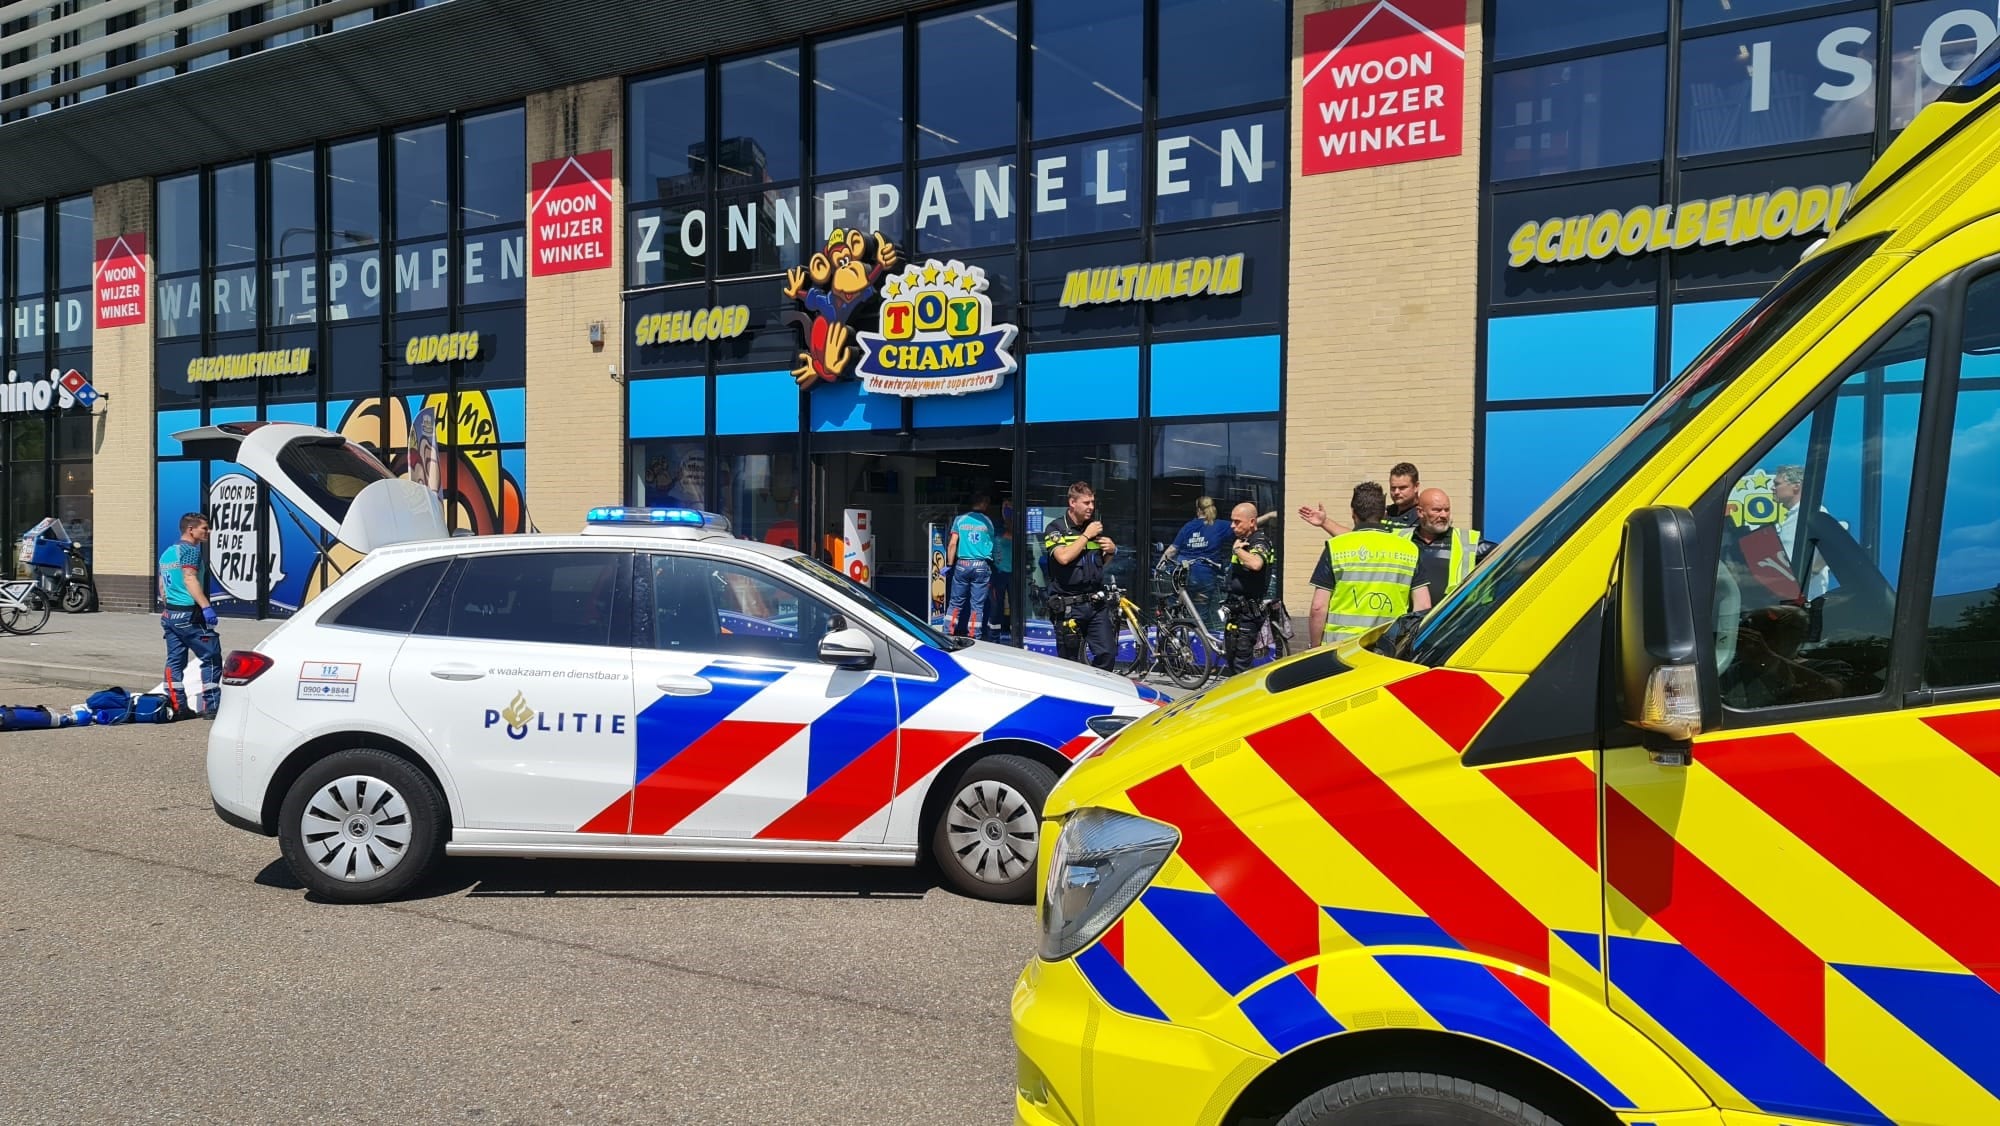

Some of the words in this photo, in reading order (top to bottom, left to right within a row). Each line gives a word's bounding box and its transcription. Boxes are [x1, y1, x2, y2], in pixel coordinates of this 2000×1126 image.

[1331, 51, 1432, 89] WOON
[1751, 4, 2000, 112] ISO
[1319, 84, 1445, 124] WIJZER
[1318, 119, 1446, 157] WINKEL
[545, 193, 597, 217] WOON
[636, 124, 1265, 263] ZONNEPANELEN
[540, 217, 603, 241] WIJZER
[1509, 182, 1860, 267] SCHOOLBENODI
[539, 241, 604, 264] WINKEL
[104, 265, 136, 282] WOON
[159, 237, 524, 321] WARMTEPOMPEN
[1060, 253, 1243, 307] MULTIMEDIA
[101, 284, 140, 301] WIJZER
[0, 300, 82, 338] HEID
[101, 303, 141, 319] WINKEL
[636, 305, 750, 346] SPEELGOED
[886, 295, 976, 334] TOY
[405, 330, 480, 366] GADGETS
[878, 341, 985, 371] CHAMP
[187, 347, 311, 383] SEIZOENARTIKELEN
[0, 368, 75, 413] ino's
[869, 376, 884, 388] the
[947, 374, 994, 390] superstore
[220, 485, 242, 500] VOOR
[244, 486, 255, 500] DE
[209, 502, 258, 532] KEUZ
[217, 533, 229, 550] EN
[231, 534, 243, 550] DE
[1351, 550, 1400, 561] POLITIE
[219, 551, 277, 582] PRIJ!
[322, 666, 338, 675] 112
[497, 667, 551, 678] waakzaam
[567, 669, 621, 680] dienstbaar
[485, 709, 626, 740] POLITIE
